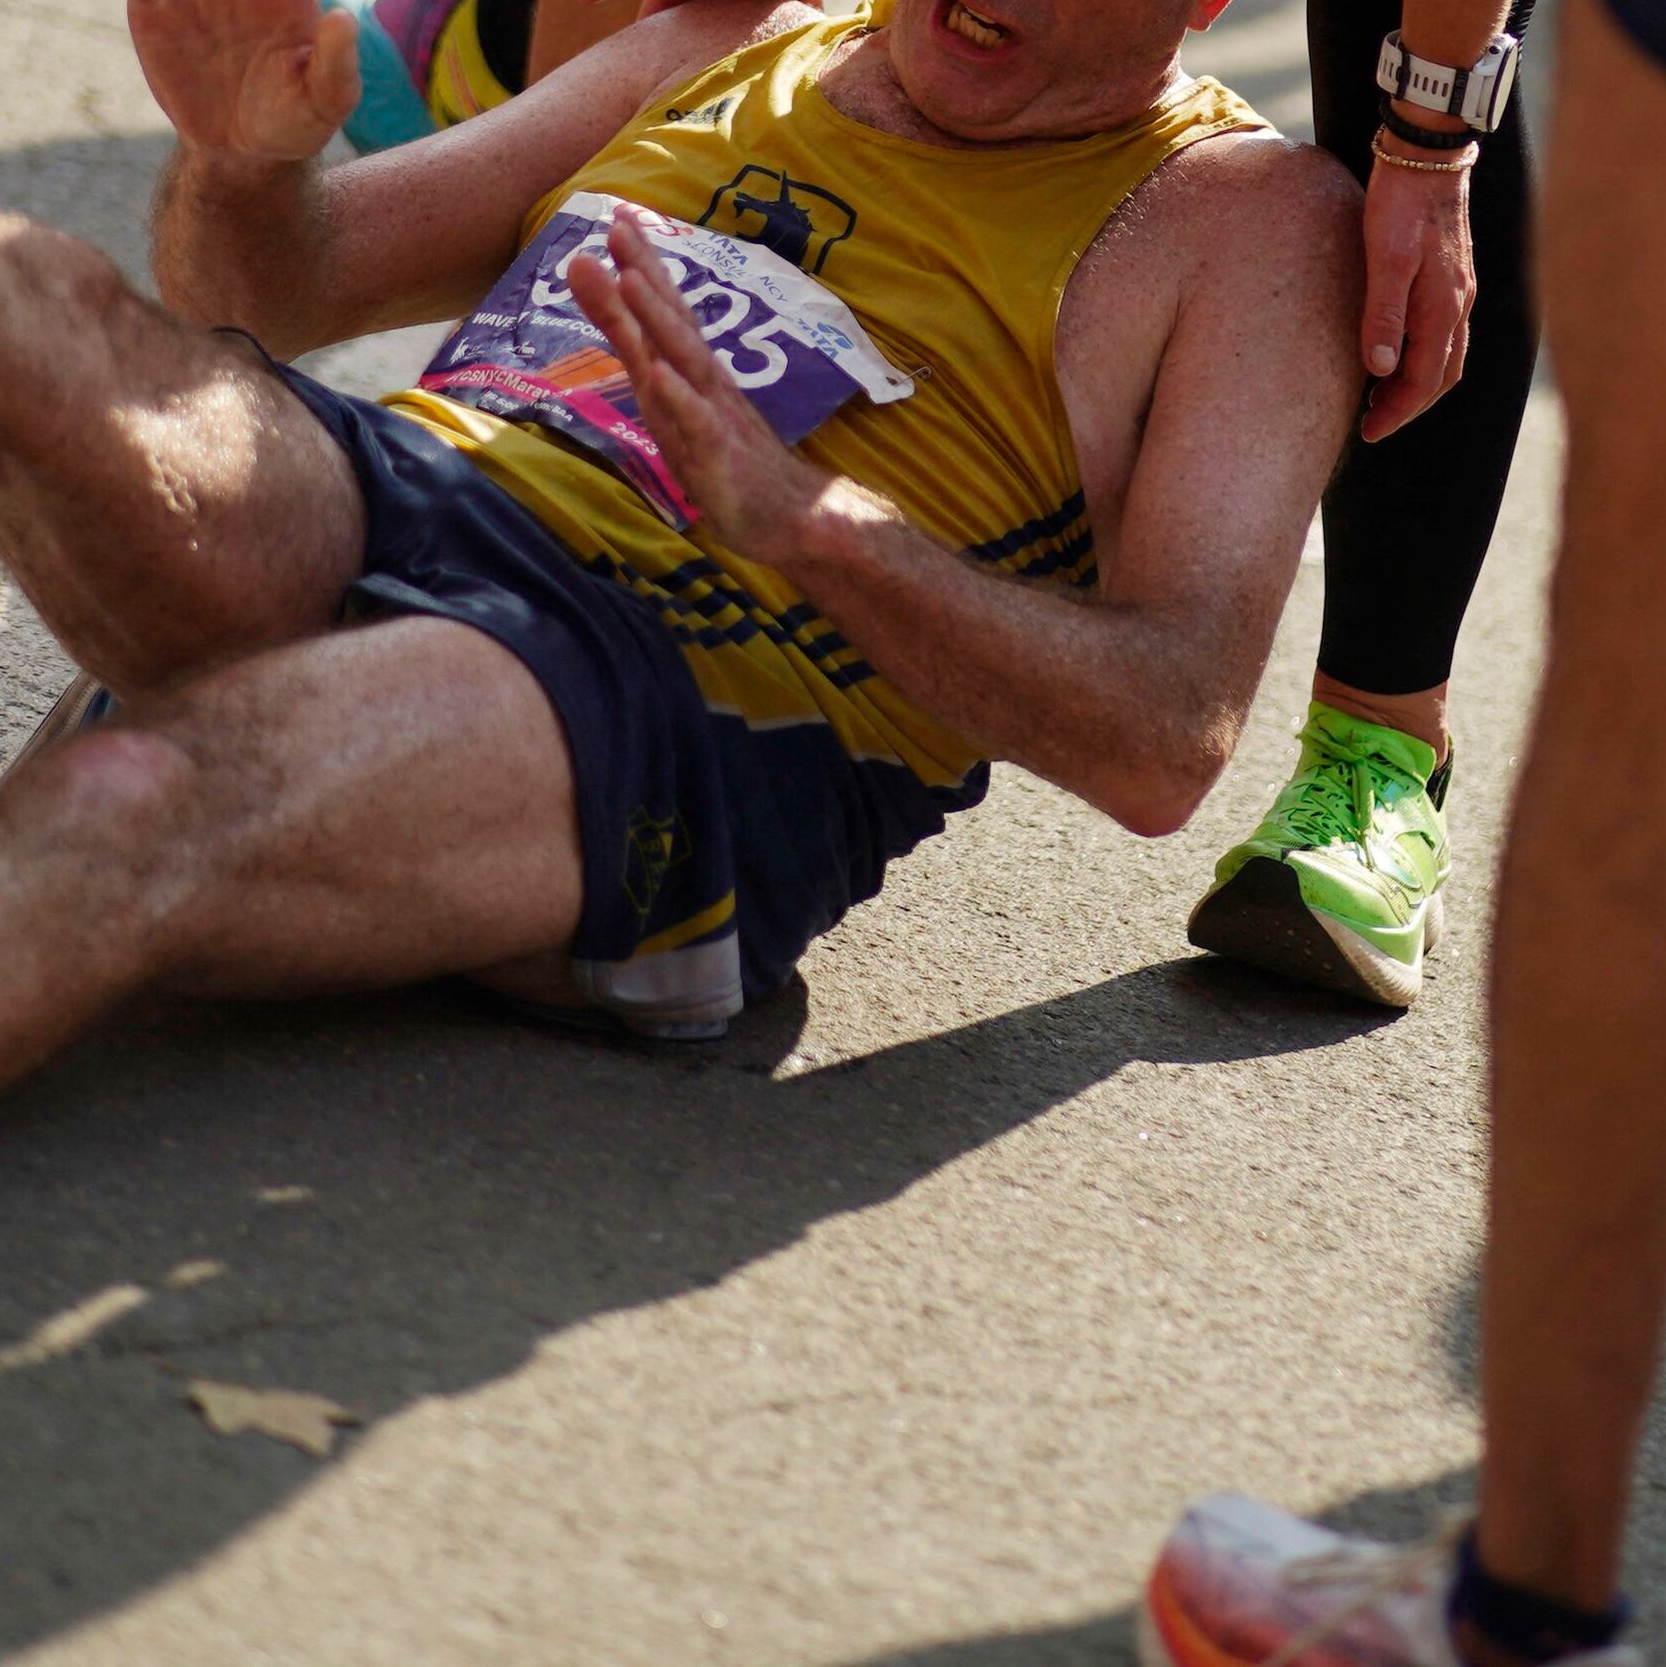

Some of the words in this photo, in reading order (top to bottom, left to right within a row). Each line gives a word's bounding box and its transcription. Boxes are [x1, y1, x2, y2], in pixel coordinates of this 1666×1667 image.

[707, 232, 749, 265] TATA
[472, 312, 518, 329] WAVE
[531, 315, 573, 329] BLUE
